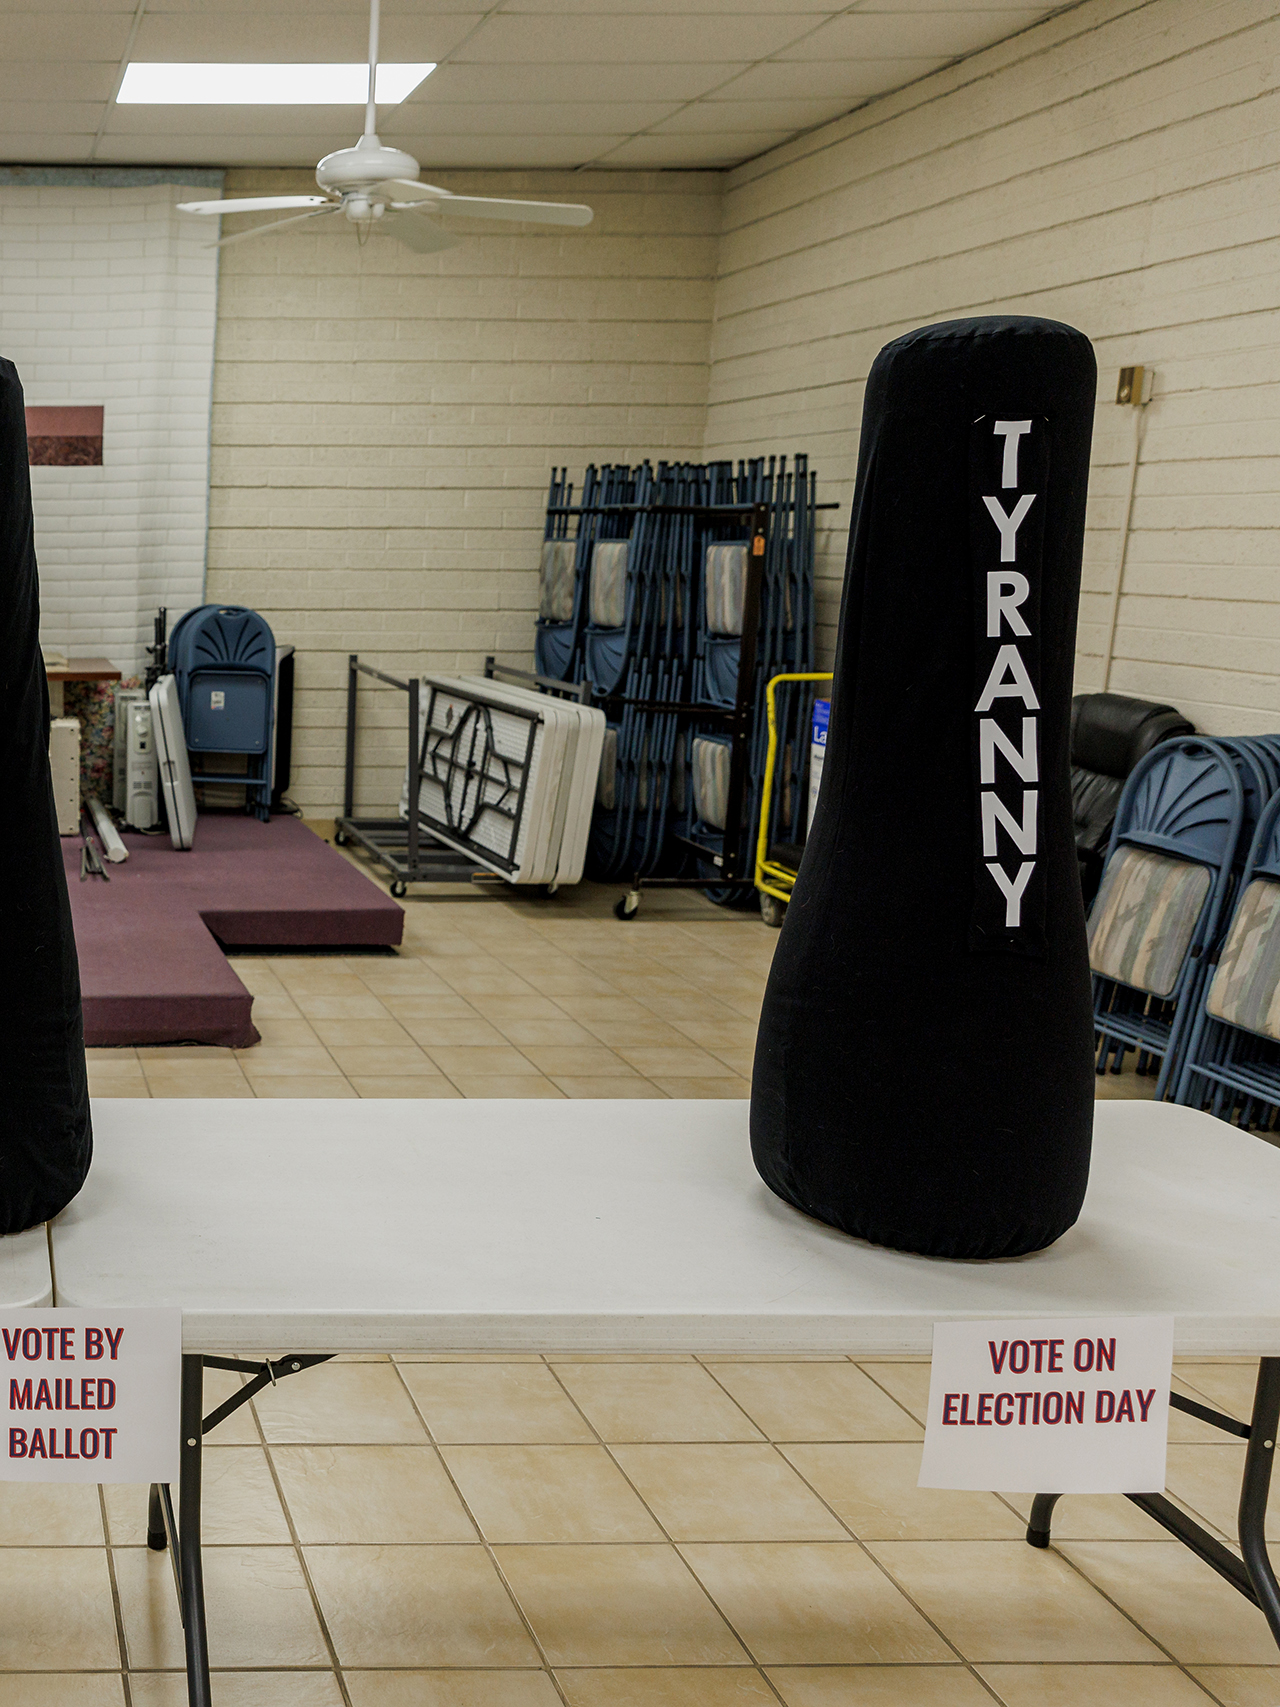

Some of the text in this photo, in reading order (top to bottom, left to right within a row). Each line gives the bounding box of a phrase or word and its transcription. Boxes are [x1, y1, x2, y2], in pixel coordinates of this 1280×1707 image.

[975, 419, 1040, 928] TYRANNY
[1, 1327, 125, 1361] VOTE BY
[988, 1337, 1117, 1375] VOTE ON
[8, 1378, 117, 1411] MAILED
[942, 1388, 1157, 1426] ELECTION DAY
[8, 1427, 118, 1460] BALLOT
